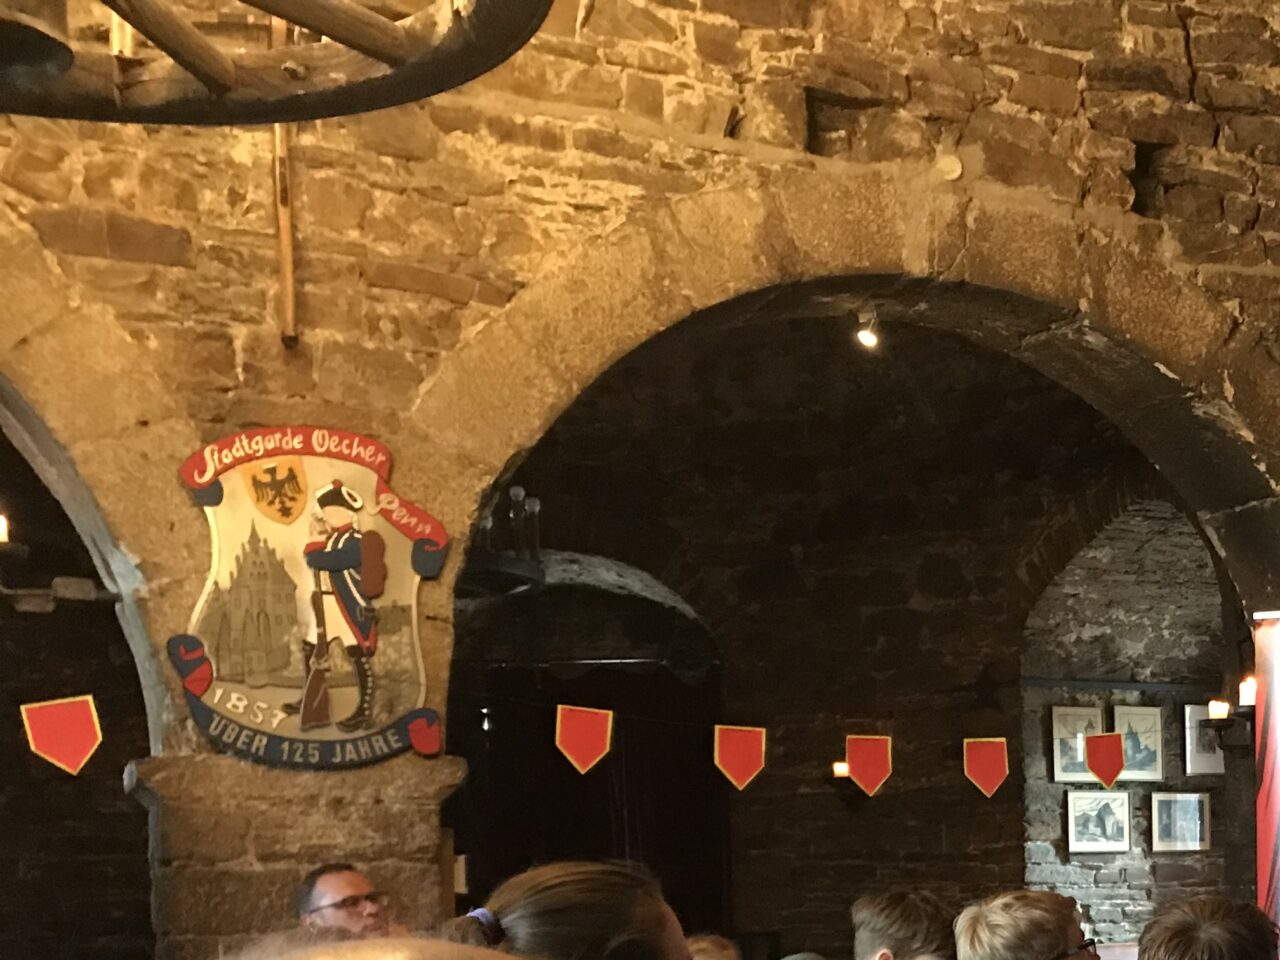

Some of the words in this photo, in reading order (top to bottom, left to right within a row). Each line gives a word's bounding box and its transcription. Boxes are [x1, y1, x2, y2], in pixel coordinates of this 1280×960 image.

[312, 429, 386, 464] Oecher
[363, 492, 432, 535] Penn
[212, 687, 289, 729] 1857
[281, 740, 320, 764] 125
[331, 729, 403, 764] JAHRE
